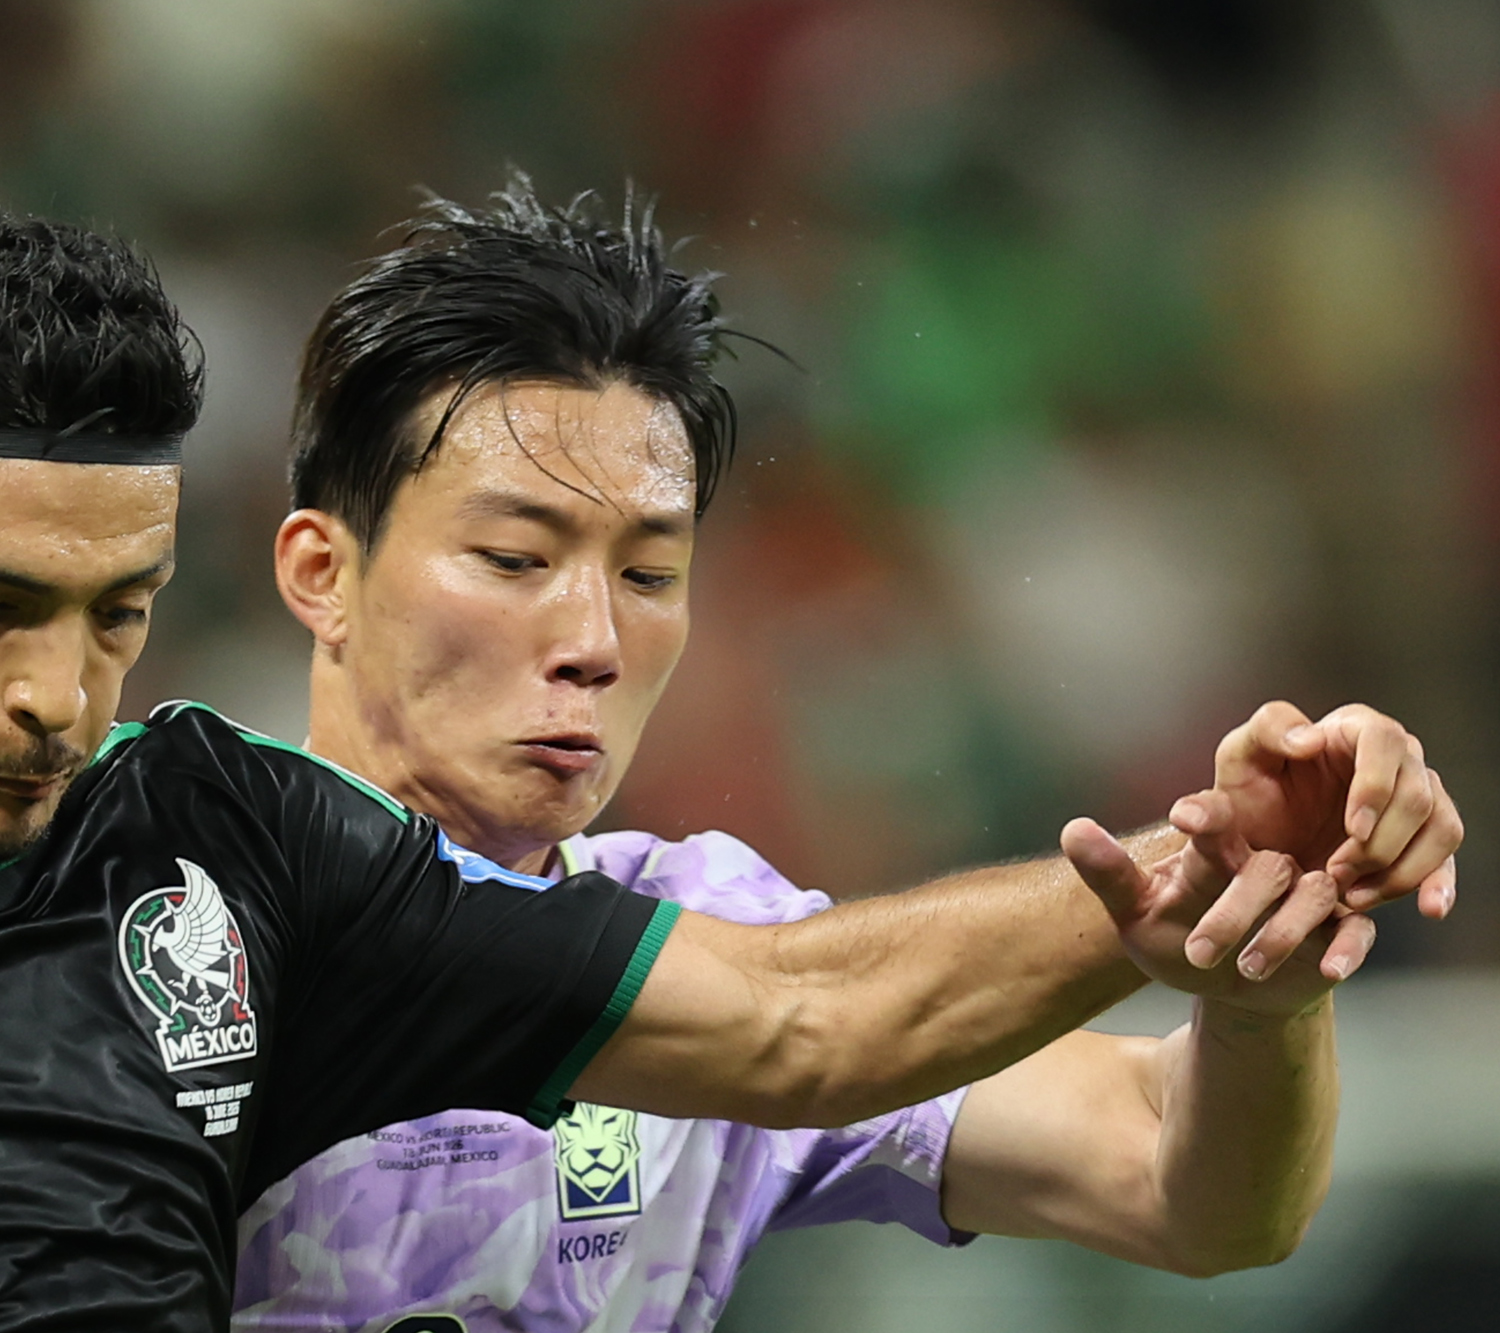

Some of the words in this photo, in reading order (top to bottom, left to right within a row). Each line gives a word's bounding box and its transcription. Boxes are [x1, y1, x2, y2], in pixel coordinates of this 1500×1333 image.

[167, 1022, 254, 1063] MÉXICO
[453, 1121, 511, 1136] REPUBLIC
[451, 1150, 498, 1164] MEXICO
